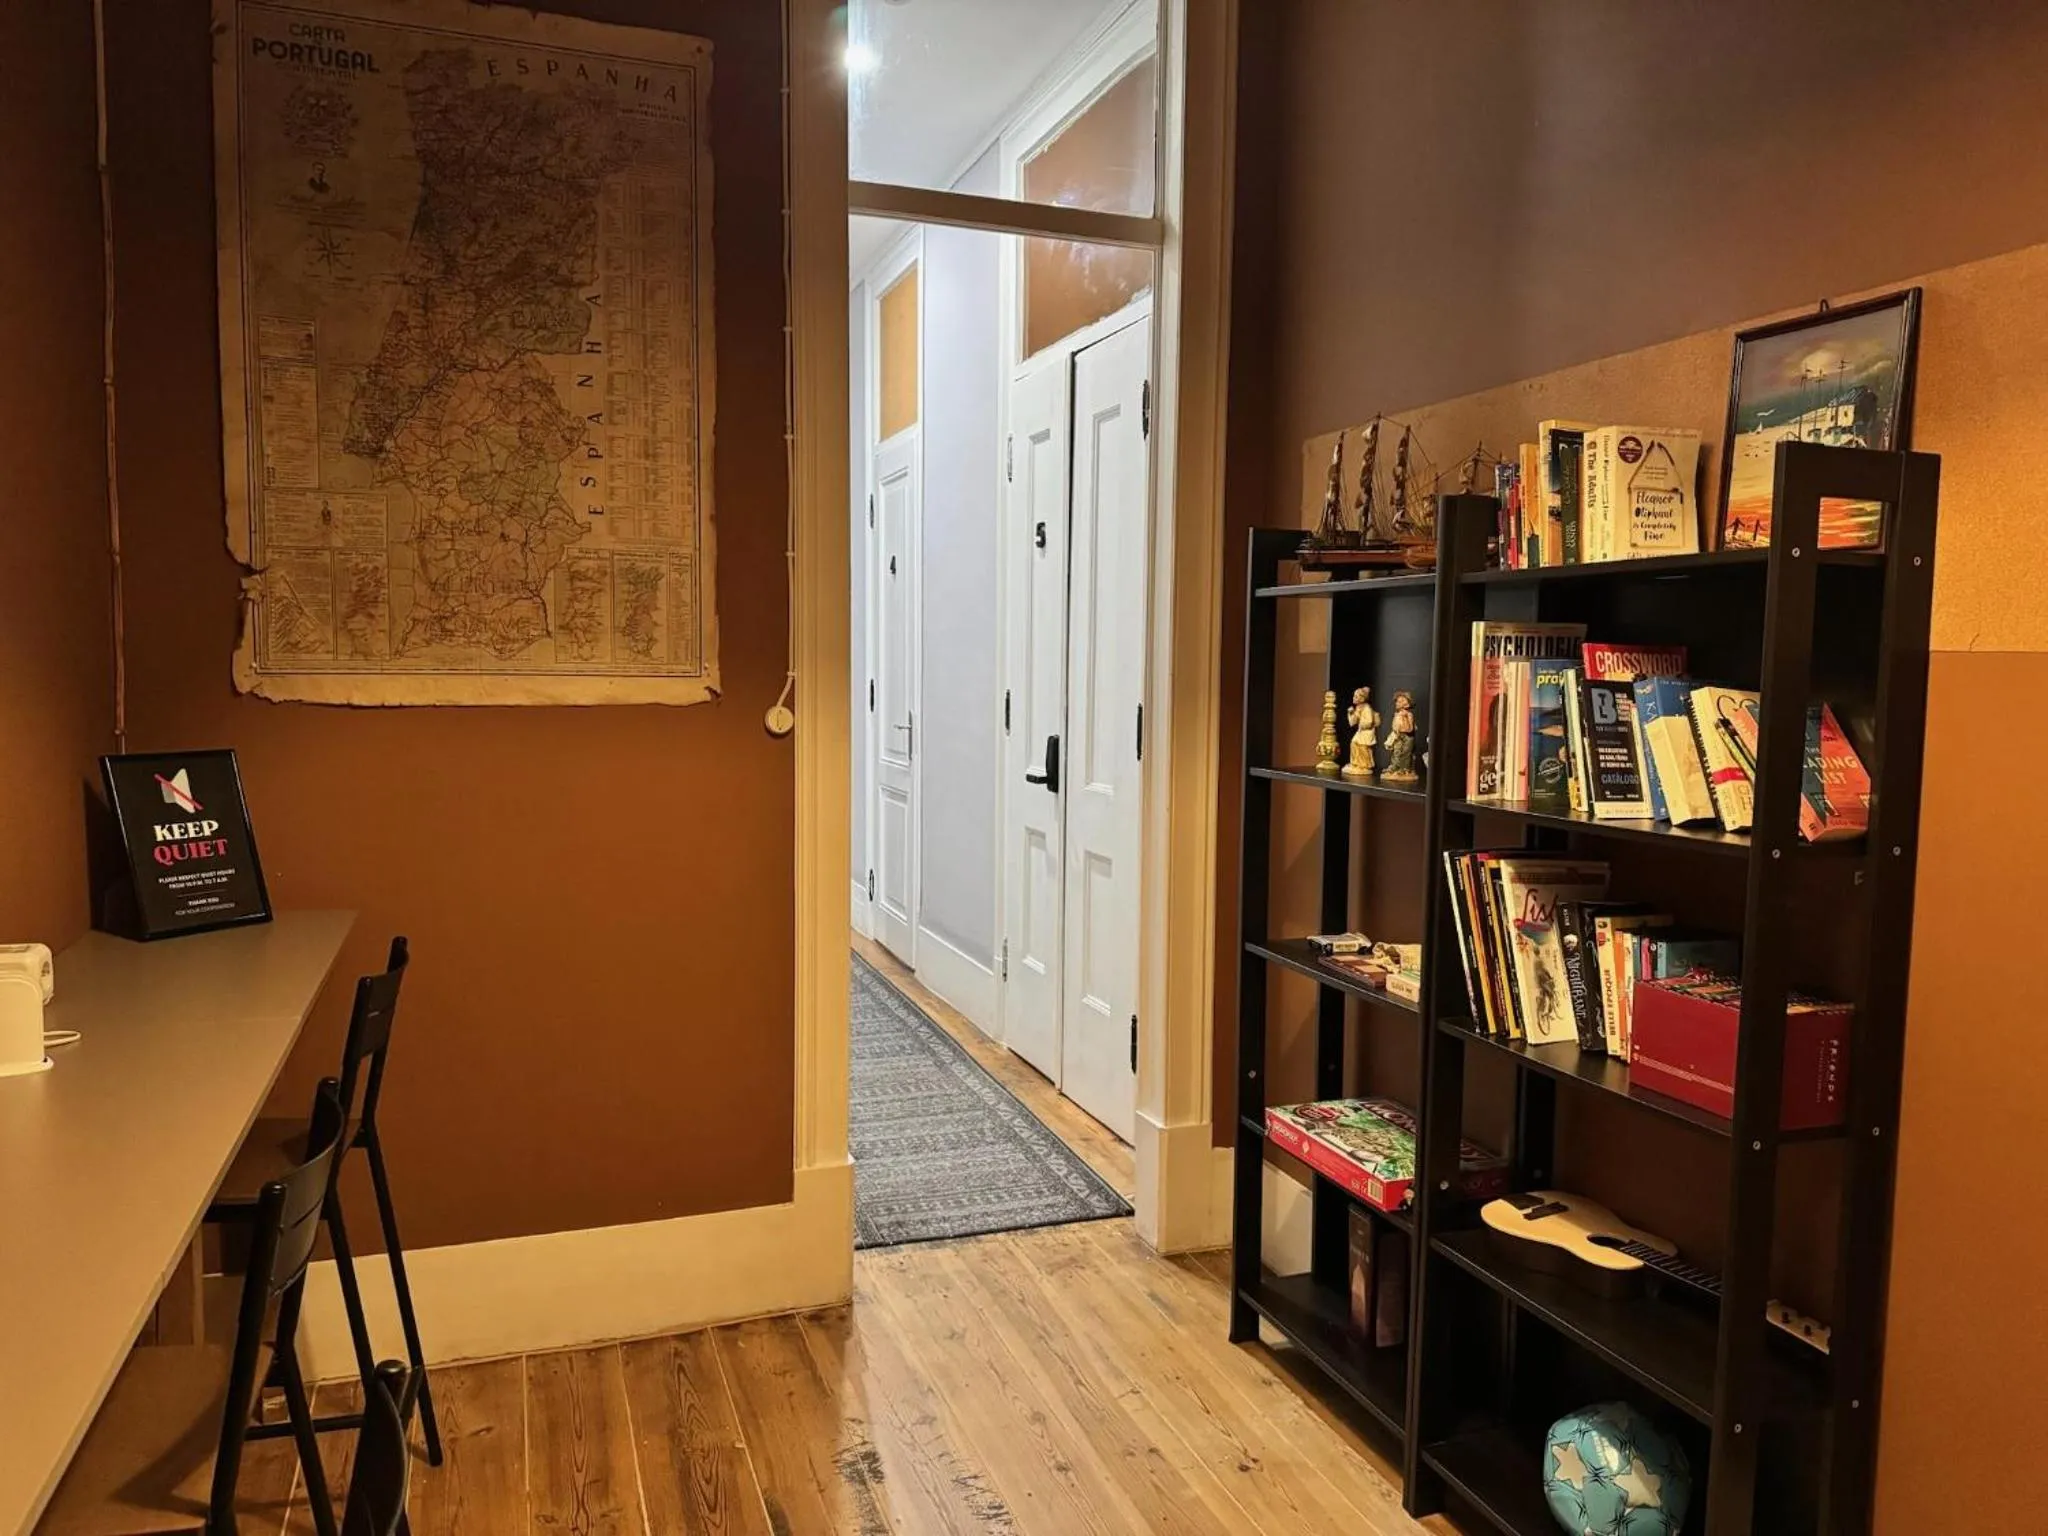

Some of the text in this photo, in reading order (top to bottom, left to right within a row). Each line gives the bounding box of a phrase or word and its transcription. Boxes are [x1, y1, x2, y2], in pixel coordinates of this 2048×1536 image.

[289, 22, 346, 43] CARTA
[252, 37, 380, 74] PORTUGAL
[486, 58, 678, 104] ESPANHA
[577, 293, 605, 516] ESPANHA
[1587, 475, 1598, 508] Adults
[1635, 490, 1676, 505] Eleanor
[1634, 506, 1674, 521] Oliphant
[1035, 521, 1047, 549] 5
[1643, 531, 1665, 542] Fine
[1595, 650, 1683, 676] CROSSWORD
[1803, 755, 1858, 769] ADING
[153, 819, 220, 843] KEEP
[153, 839, 228, 864] QUIET
[1606, 1011, 1617, 1036] BELLE
